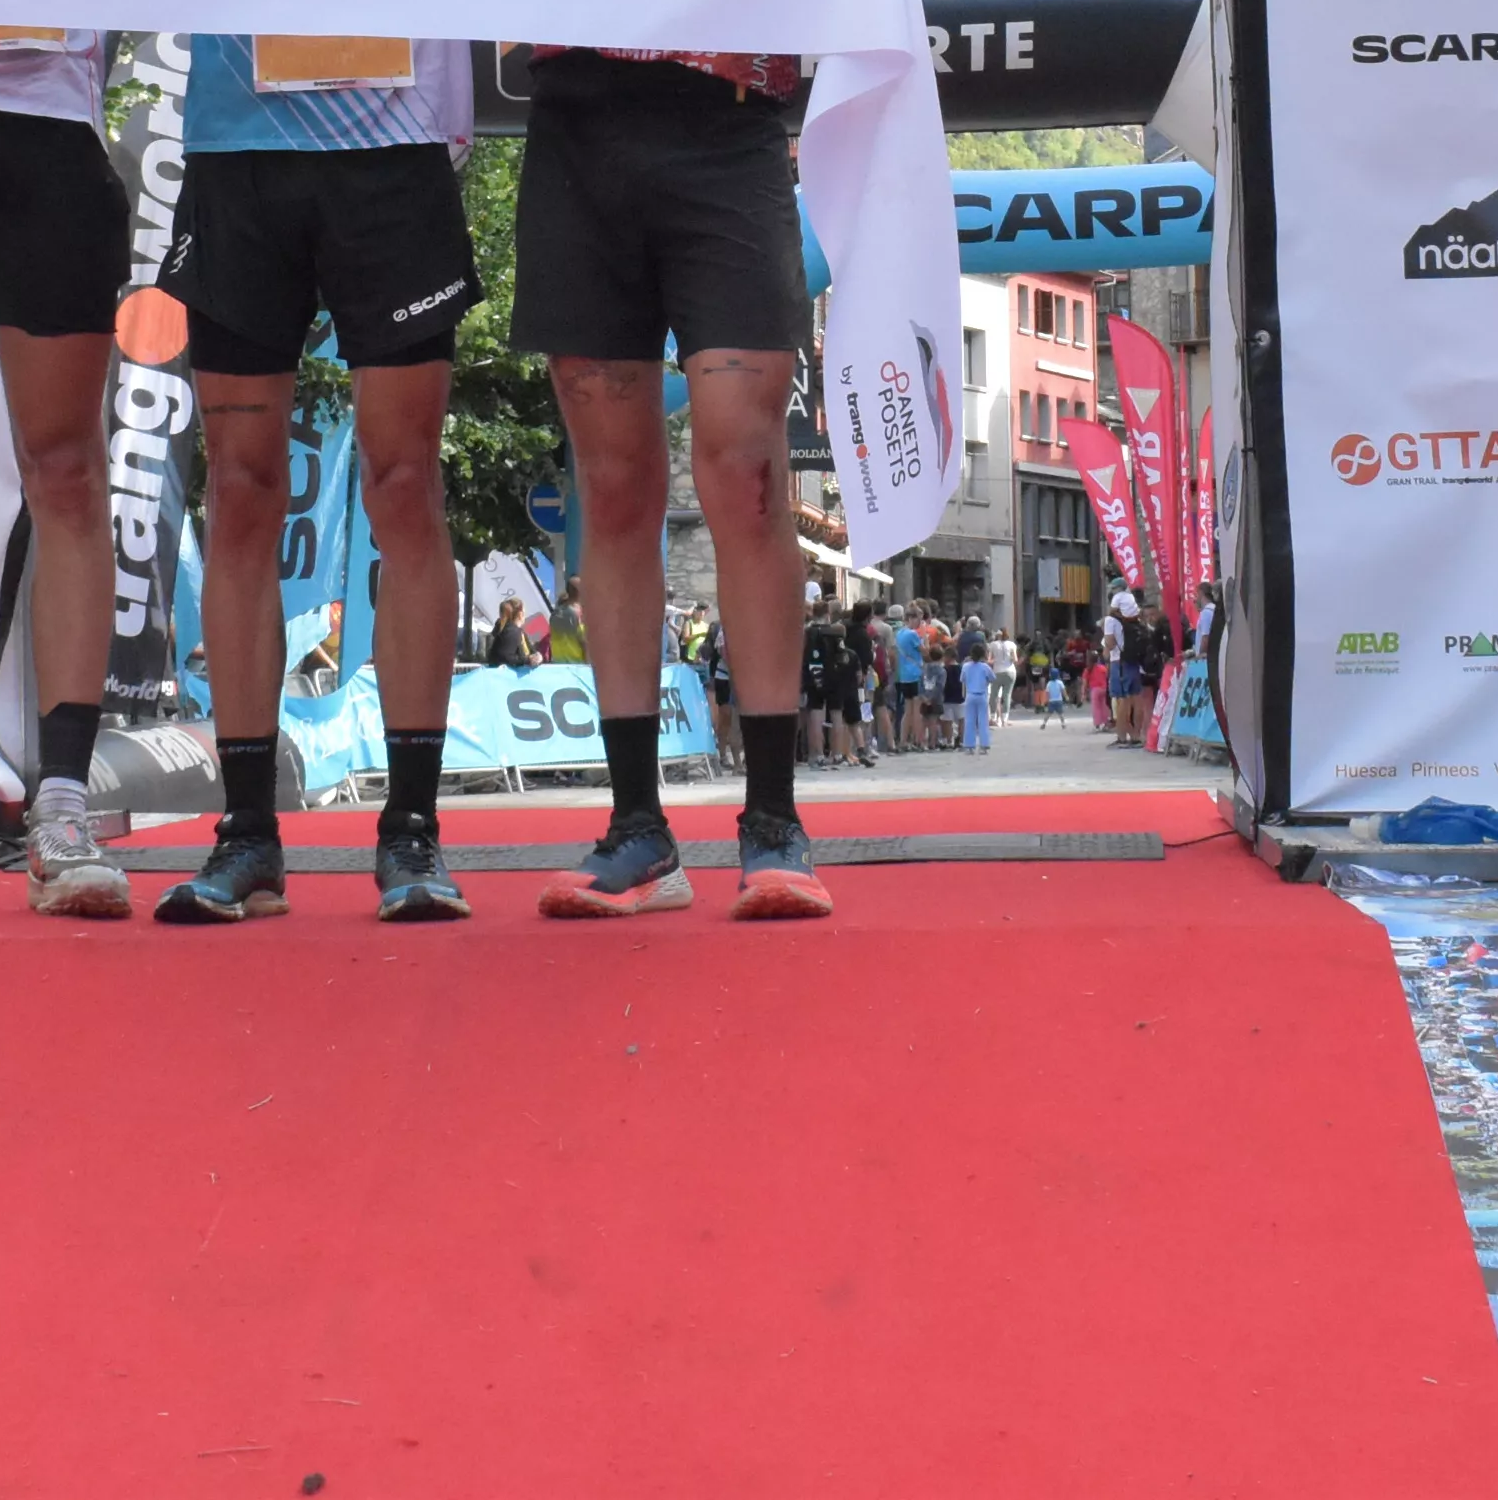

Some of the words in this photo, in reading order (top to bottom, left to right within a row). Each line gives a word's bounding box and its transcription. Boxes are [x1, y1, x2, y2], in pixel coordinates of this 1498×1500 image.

[958, 185, 1215, 242] CARP
[408, 278, 466, 315] SCARPA
[839, 364, 853, 385] by
[877, 387, 906, 488] POSETS
[898, 395, 922, 479] ANETO
[1387, 477, 1412, 486] GRAN
[1413, 477, 1438, 485] TRAIL
[1336, 763, 1397, 778] Huesca
[1412, 762, 1479, 778] Pirineos
